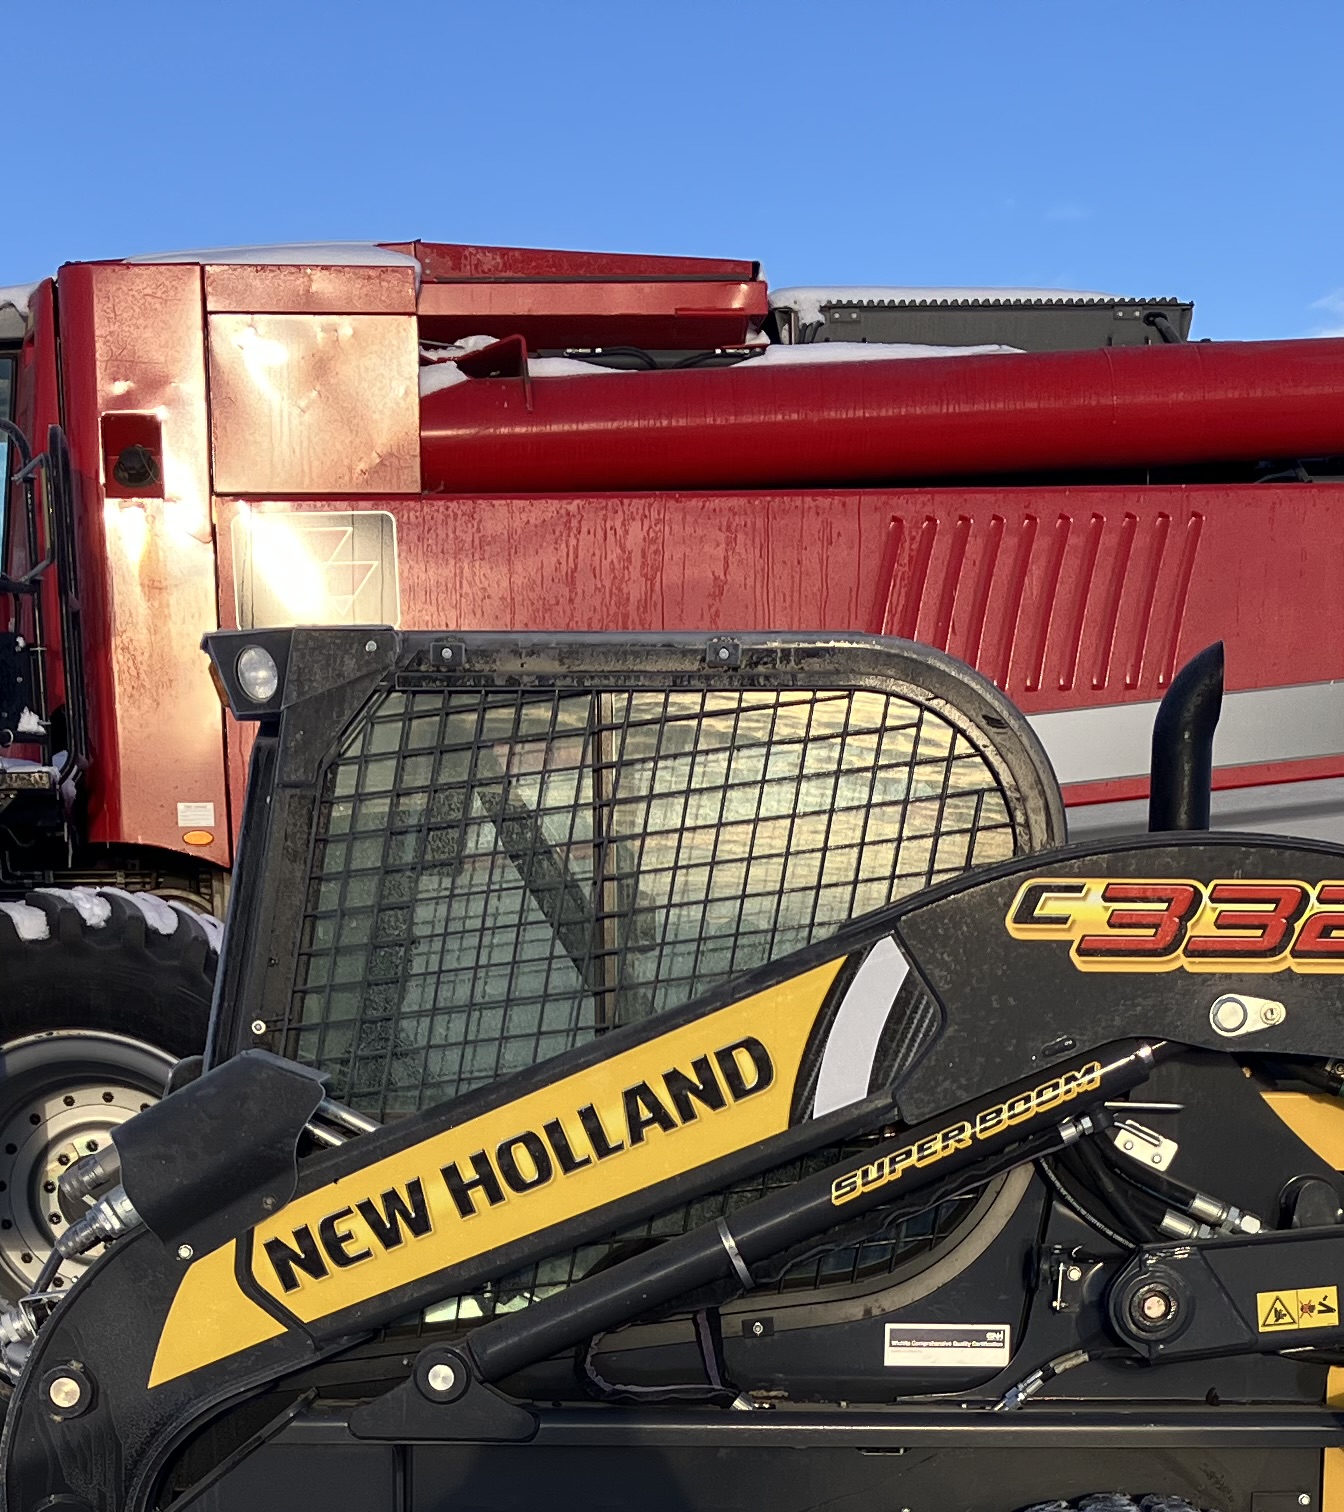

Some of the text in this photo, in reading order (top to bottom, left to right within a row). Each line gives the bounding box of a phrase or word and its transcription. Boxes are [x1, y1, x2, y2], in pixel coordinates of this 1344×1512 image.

[263, 1036, 774, 1293] NEW HOLLAND
[832, 1121, 972, 1206] SUPER
[976, 1062, 1101, 1139] BOOM
